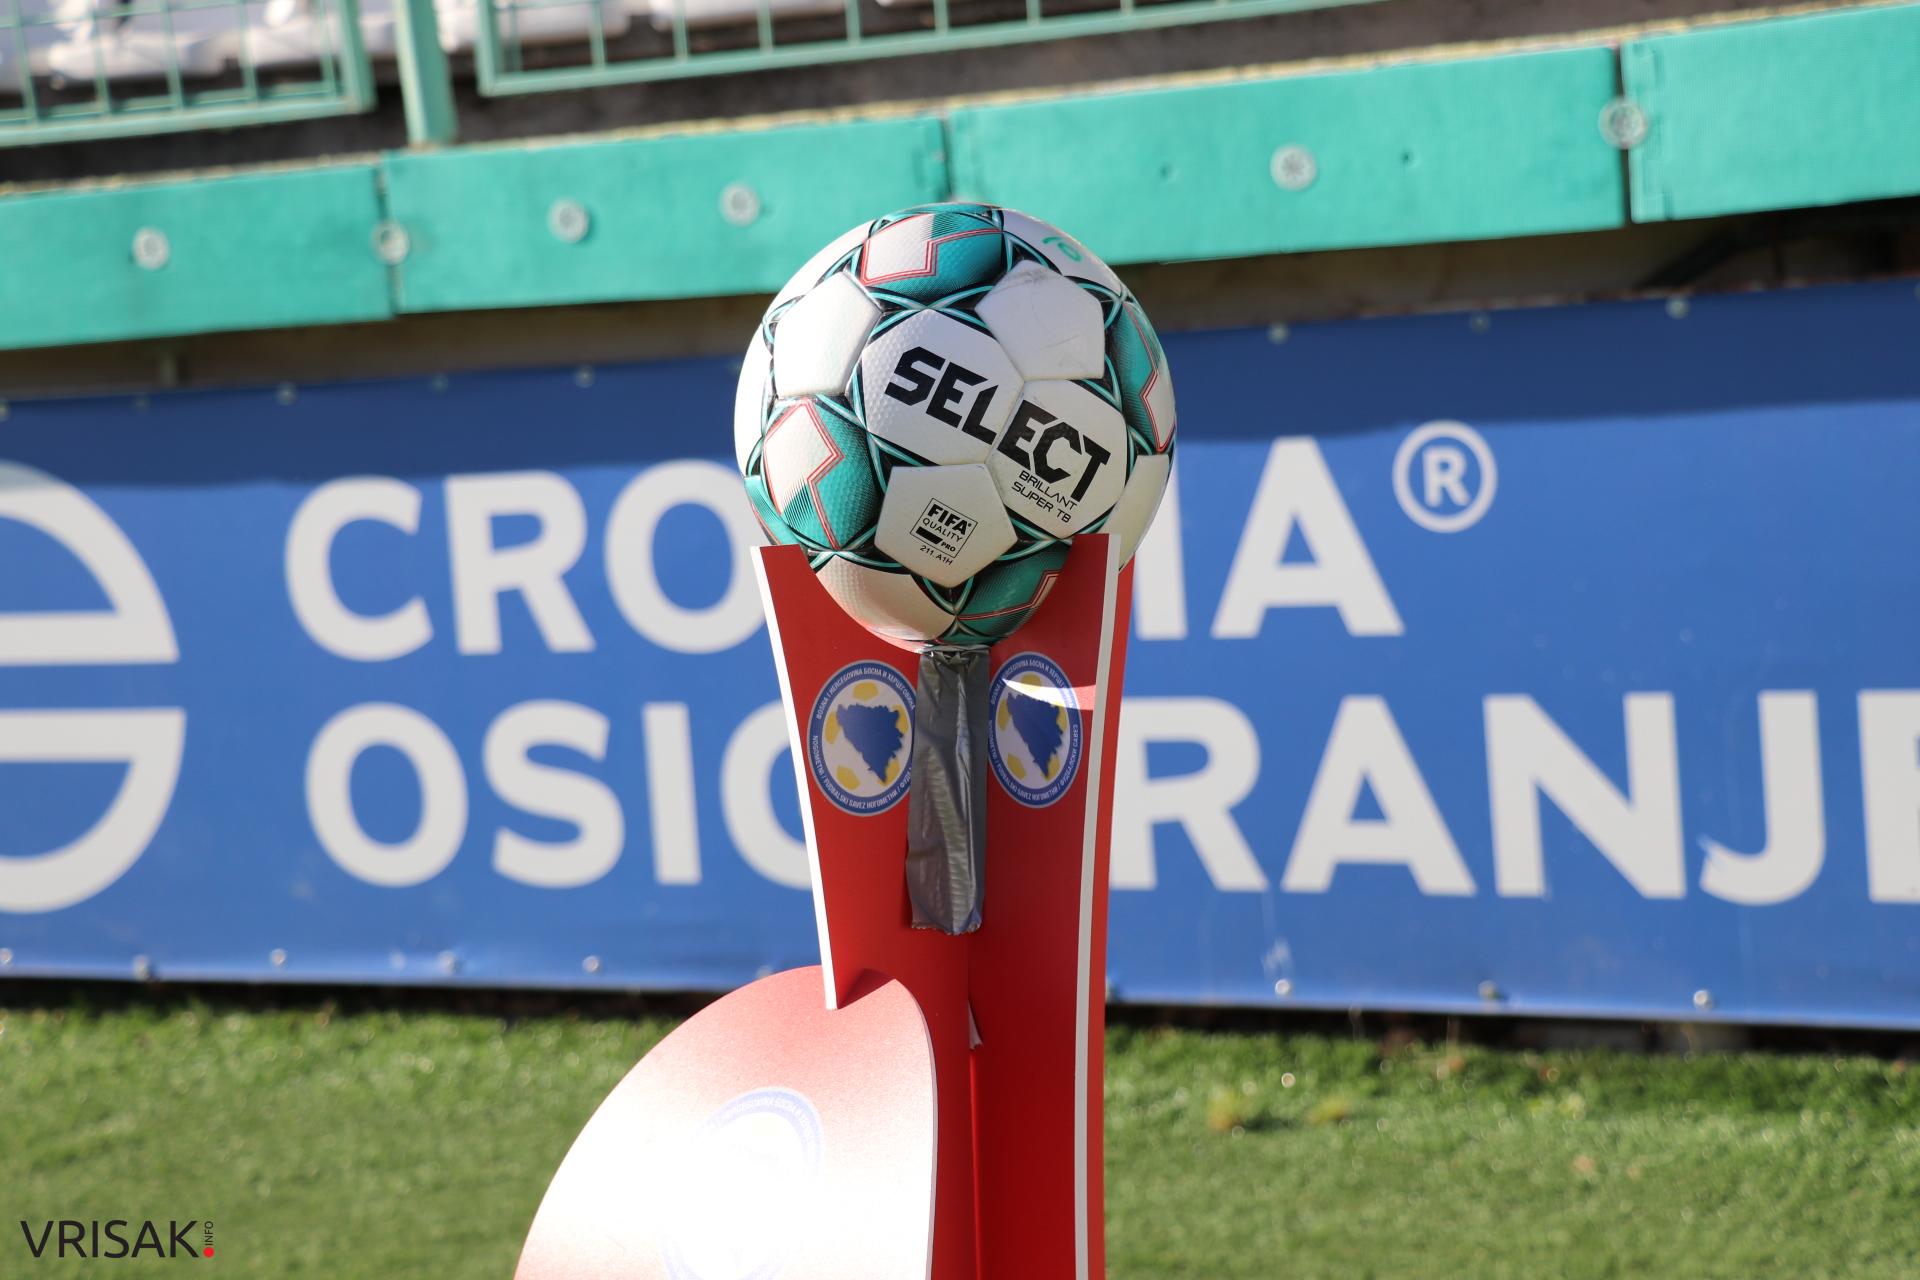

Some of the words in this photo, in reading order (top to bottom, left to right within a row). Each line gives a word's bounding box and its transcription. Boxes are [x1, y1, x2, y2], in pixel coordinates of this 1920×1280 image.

[884, 346, 1111, 502] SELECT
[1011, 481, 1054, 512] SUPER
[1056, 509, 1072, 523] TB
[1018, 470, 1077, 510] BRILLANT
[922, 517, 963, 542] QUALITY
[927, 503, 968, 535] FIFA
[940, 541, 956, 552] PRO
[303, 688, 1920, 905] OSIRANJ
